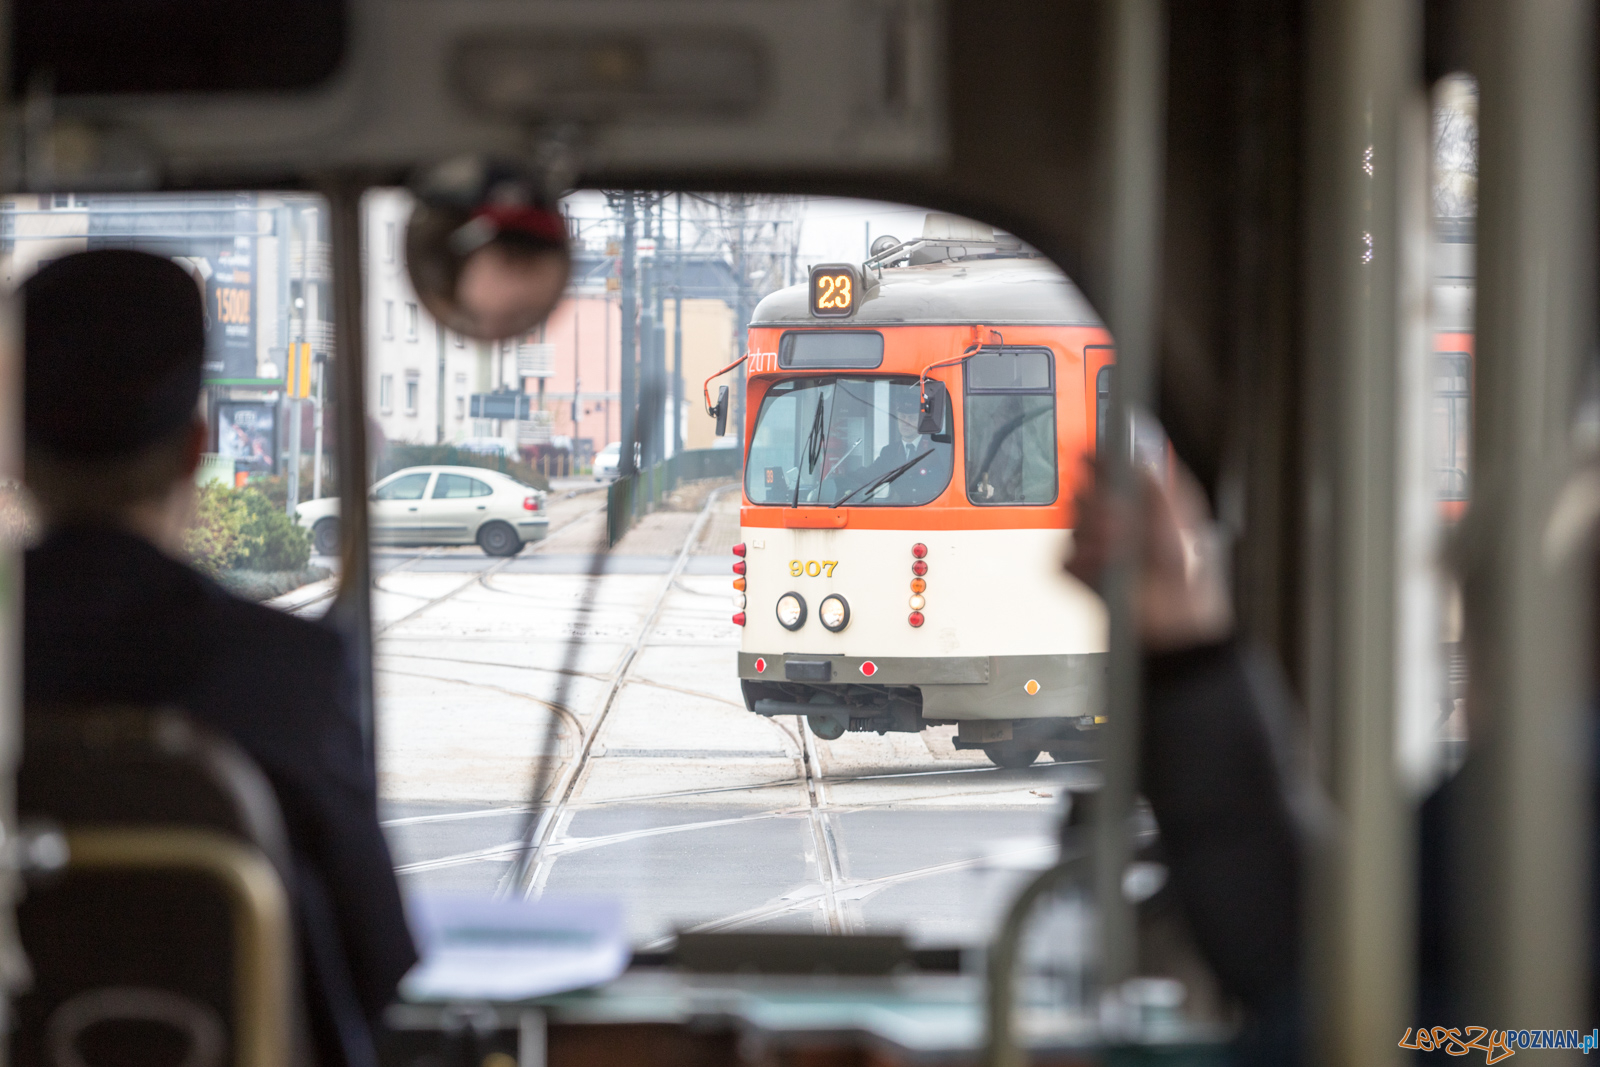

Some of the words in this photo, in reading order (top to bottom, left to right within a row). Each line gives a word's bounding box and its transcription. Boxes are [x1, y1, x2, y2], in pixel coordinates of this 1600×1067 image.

[819, 275, 851, 308] 23
[748, 347, 778, 373] ztm
[788, 559, 839, 578] 907
